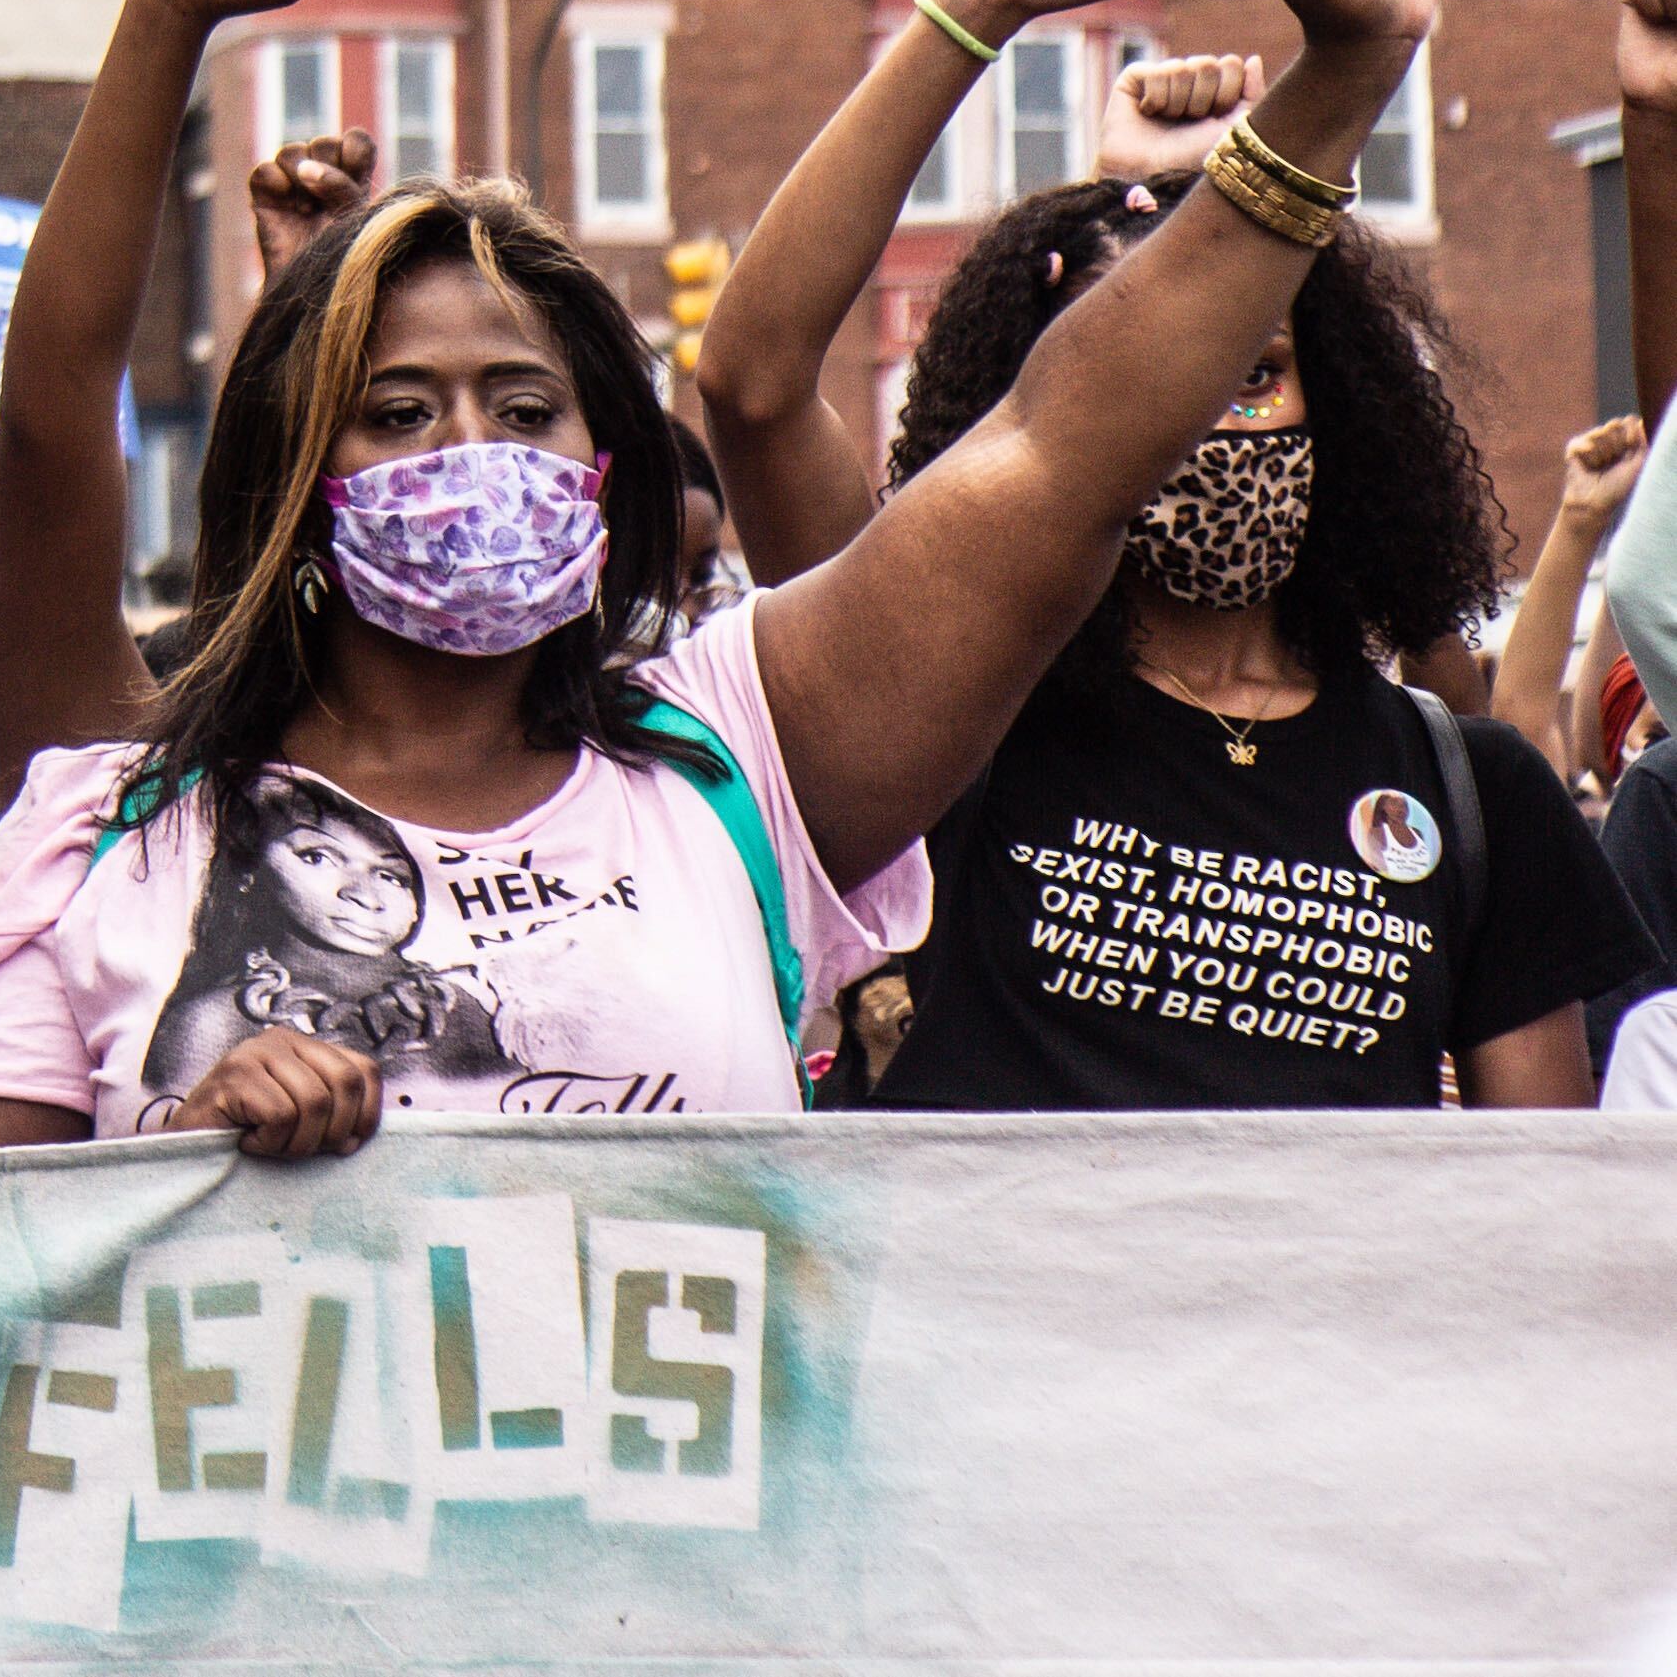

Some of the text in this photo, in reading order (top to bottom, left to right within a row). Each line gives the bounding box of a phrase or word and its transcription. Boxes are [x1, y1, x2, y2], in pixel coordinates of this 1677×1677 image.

[1009, 843, 1433, 953] SEXIST, HOMOPHOBIC
[1072, 817, 1162, 858] WHY
[1170, 845, 1224, 877] BE
[1231, 855, 1386, 908] RACIST,
[1031, 919, 1407, 1021] WHEN YOU COULD
[1042, 885, 1411, 983] OR TRANSPHOBIC
[1042, 967, 1381, 1055] JUST BE QUIET?
